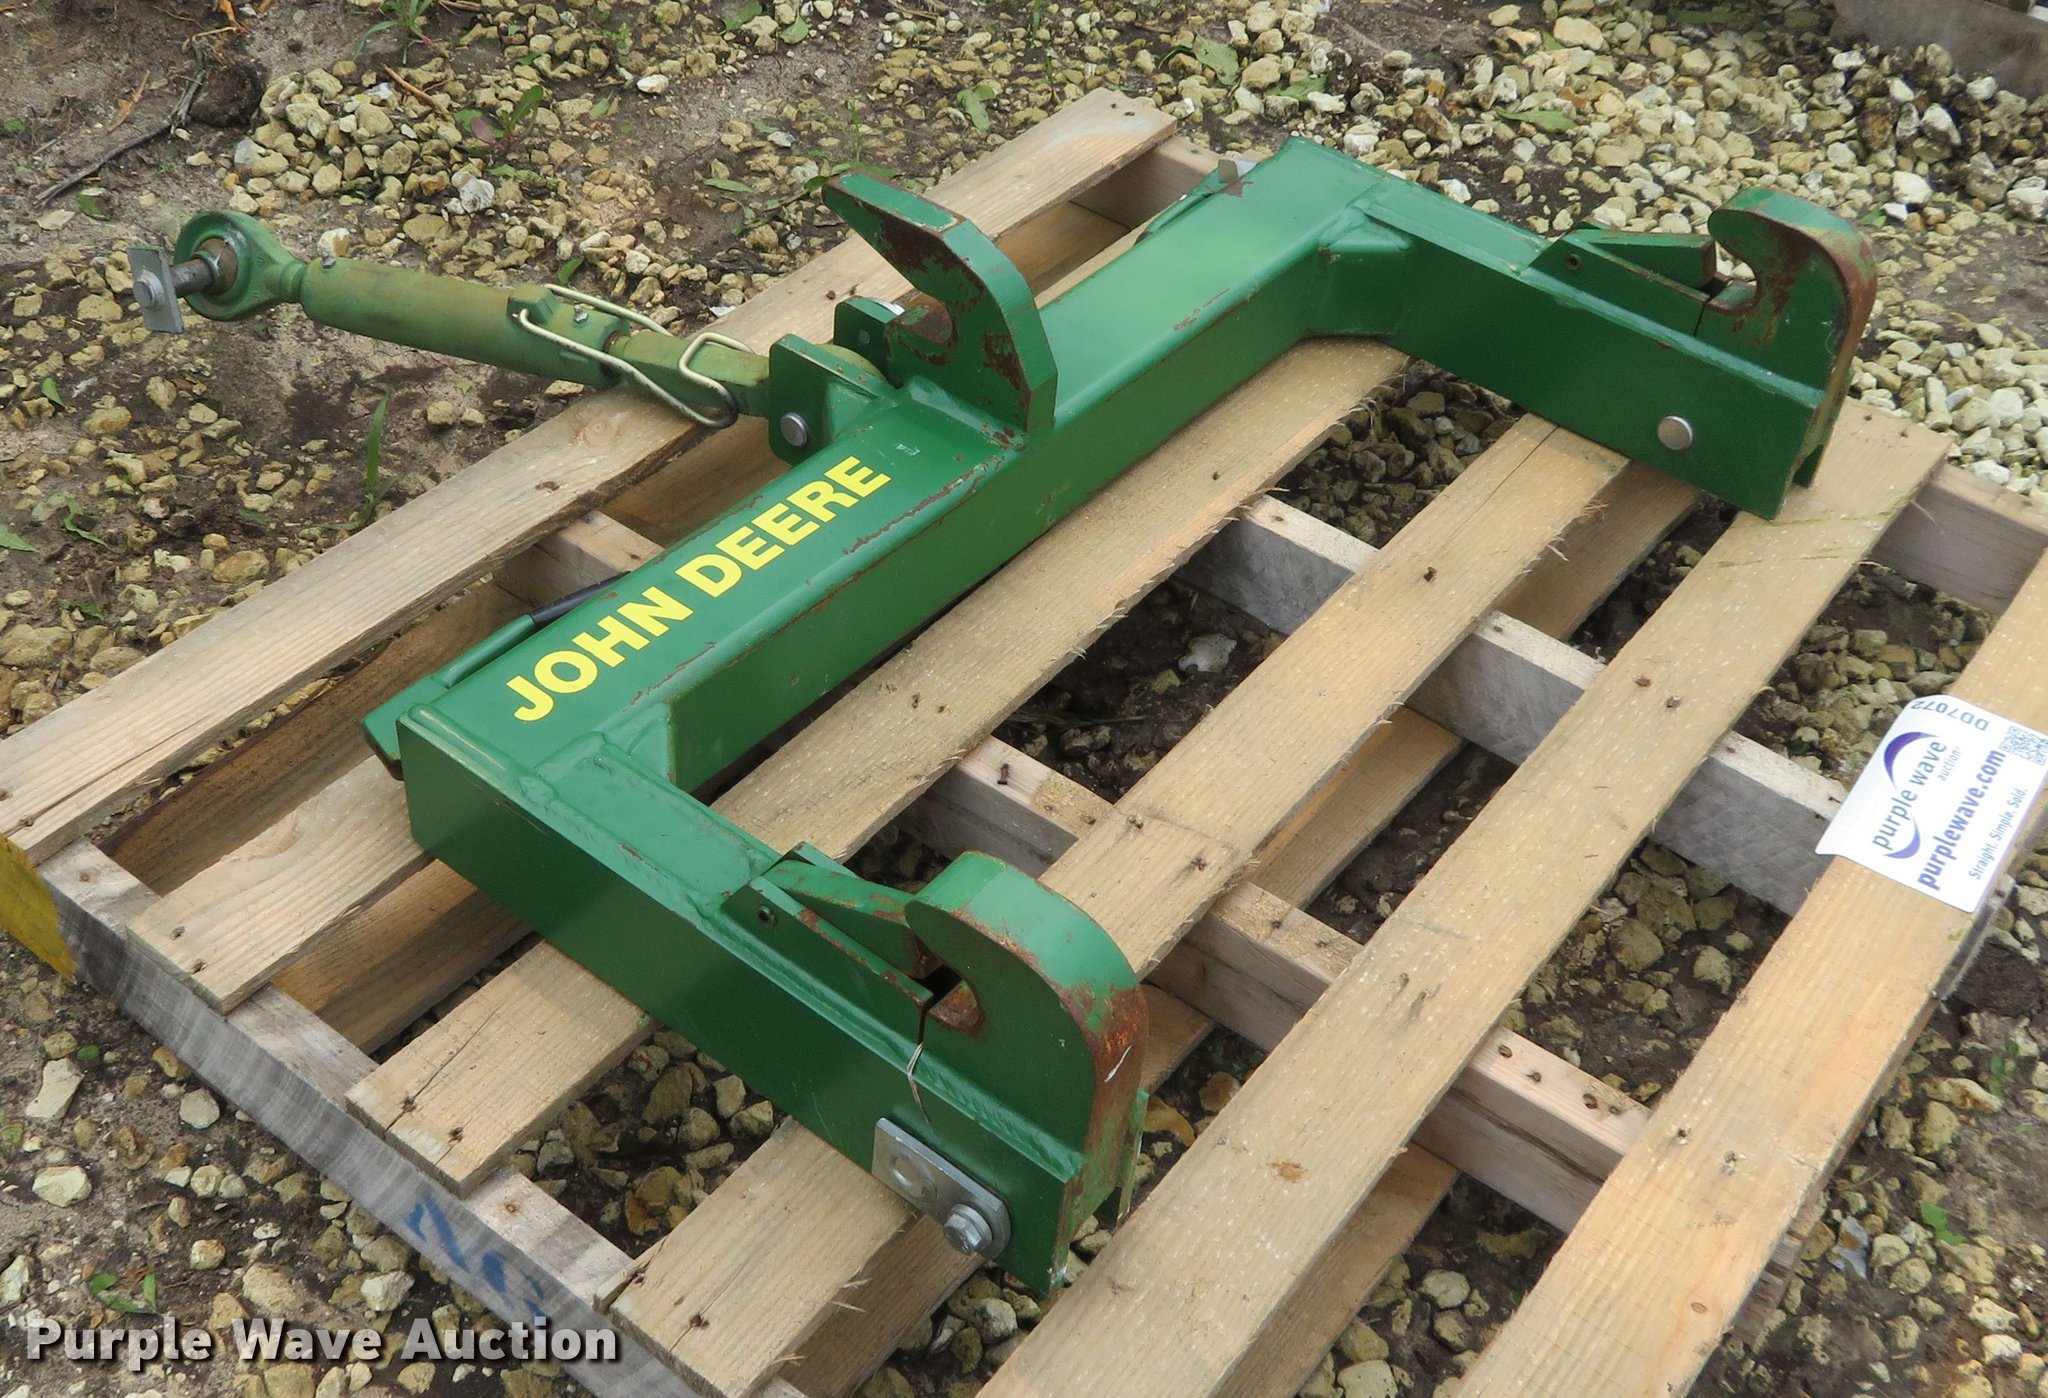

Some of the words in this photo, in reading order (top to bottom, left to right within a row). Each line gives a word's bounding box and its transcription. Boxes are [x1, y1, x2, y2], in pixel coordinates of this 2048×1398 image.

[506, 586, 694, 722] JOHN
[675, 455, 892, 598] DEERE
[1911, 700, 1989, 731] DD7072
[1872, 789, 1918, 851] purple
[1908, 741, 1947, 787] wave
[1917, 750, 2006, 891] purplewave.com
[1968, 841, 1998, 880] Straight.
[1989, 809, 2017, 841] Simple.
[2006, 788, 2028, 809] Sold.
